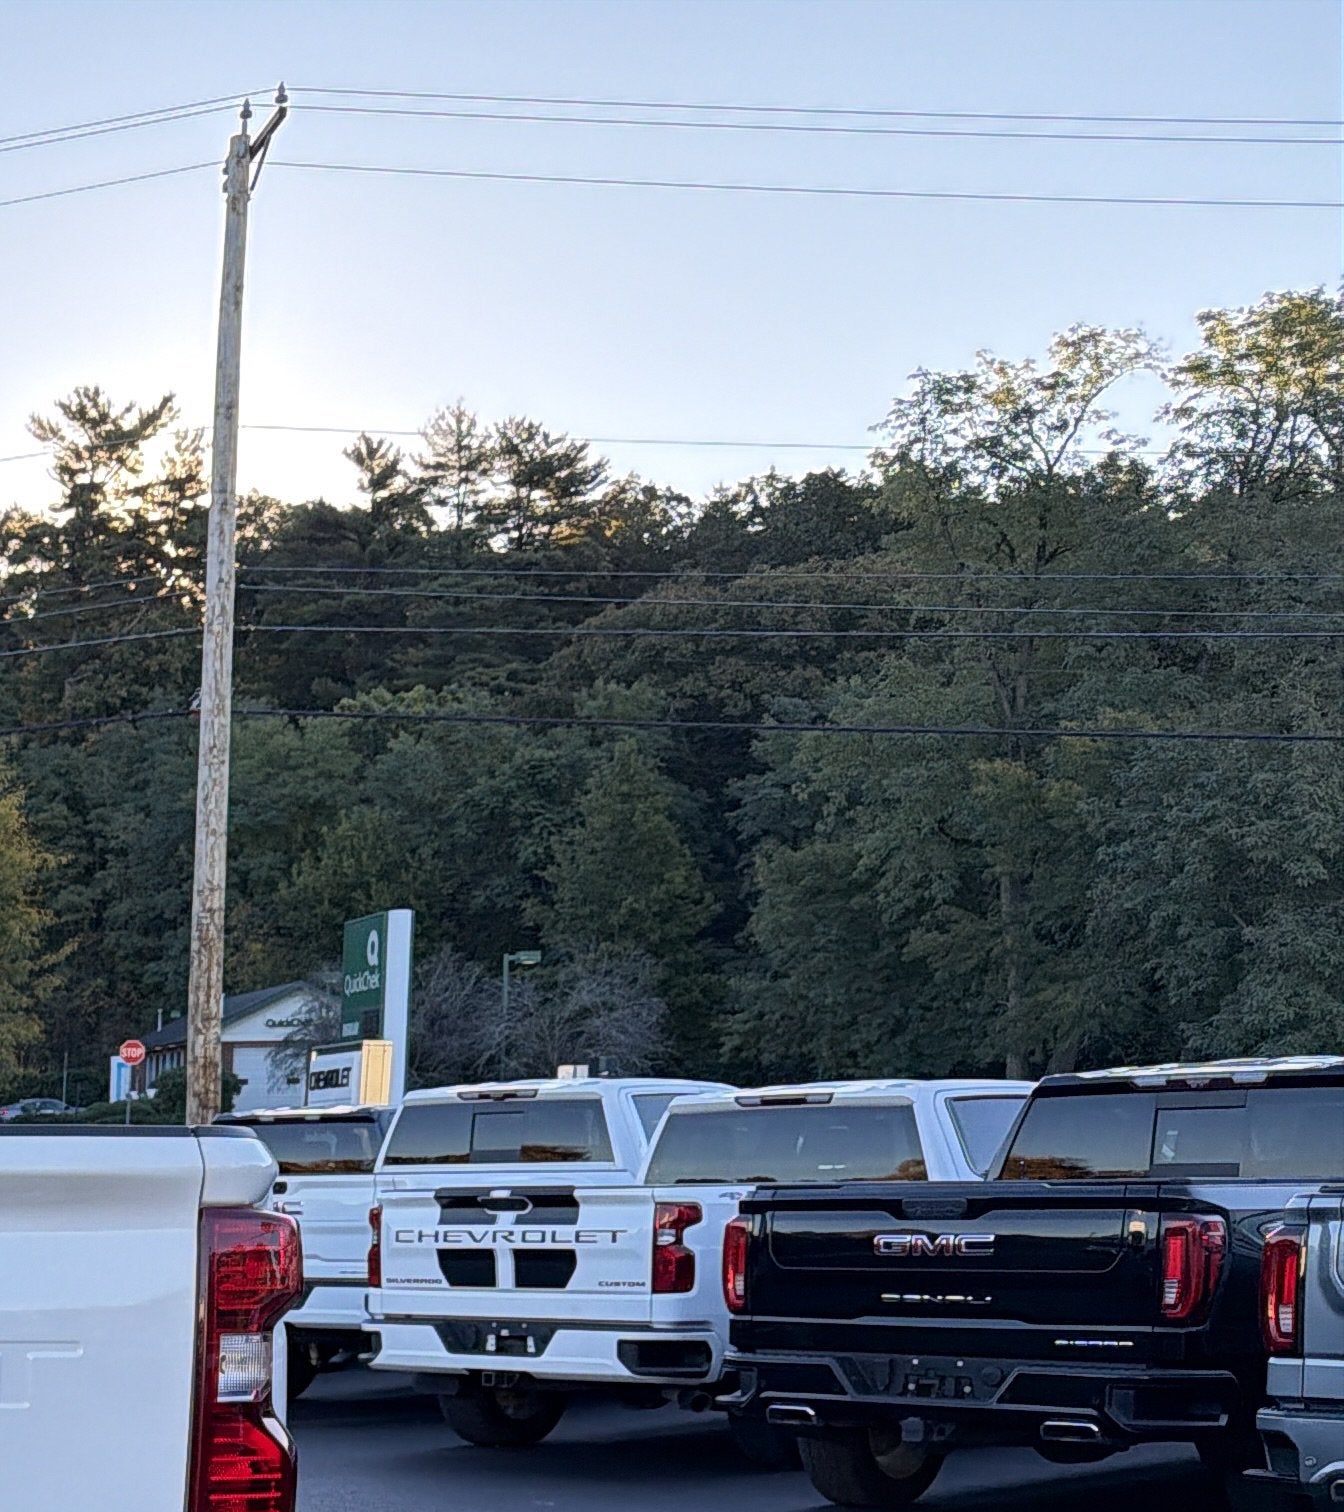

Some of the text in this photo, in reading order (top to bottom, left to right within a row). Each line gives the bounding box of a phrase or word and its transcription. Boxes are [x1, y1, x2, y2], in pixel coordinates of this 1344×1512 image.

[122, 1047, 142, 1059] STOP
[395, 1229, 628, 1244] CHEVROLET
[873, 1233, 995, 1257] GMC
[385, 1277, 443, 1285] SILVERADO
[598, 1280, 647, 1288] CUSTOM
